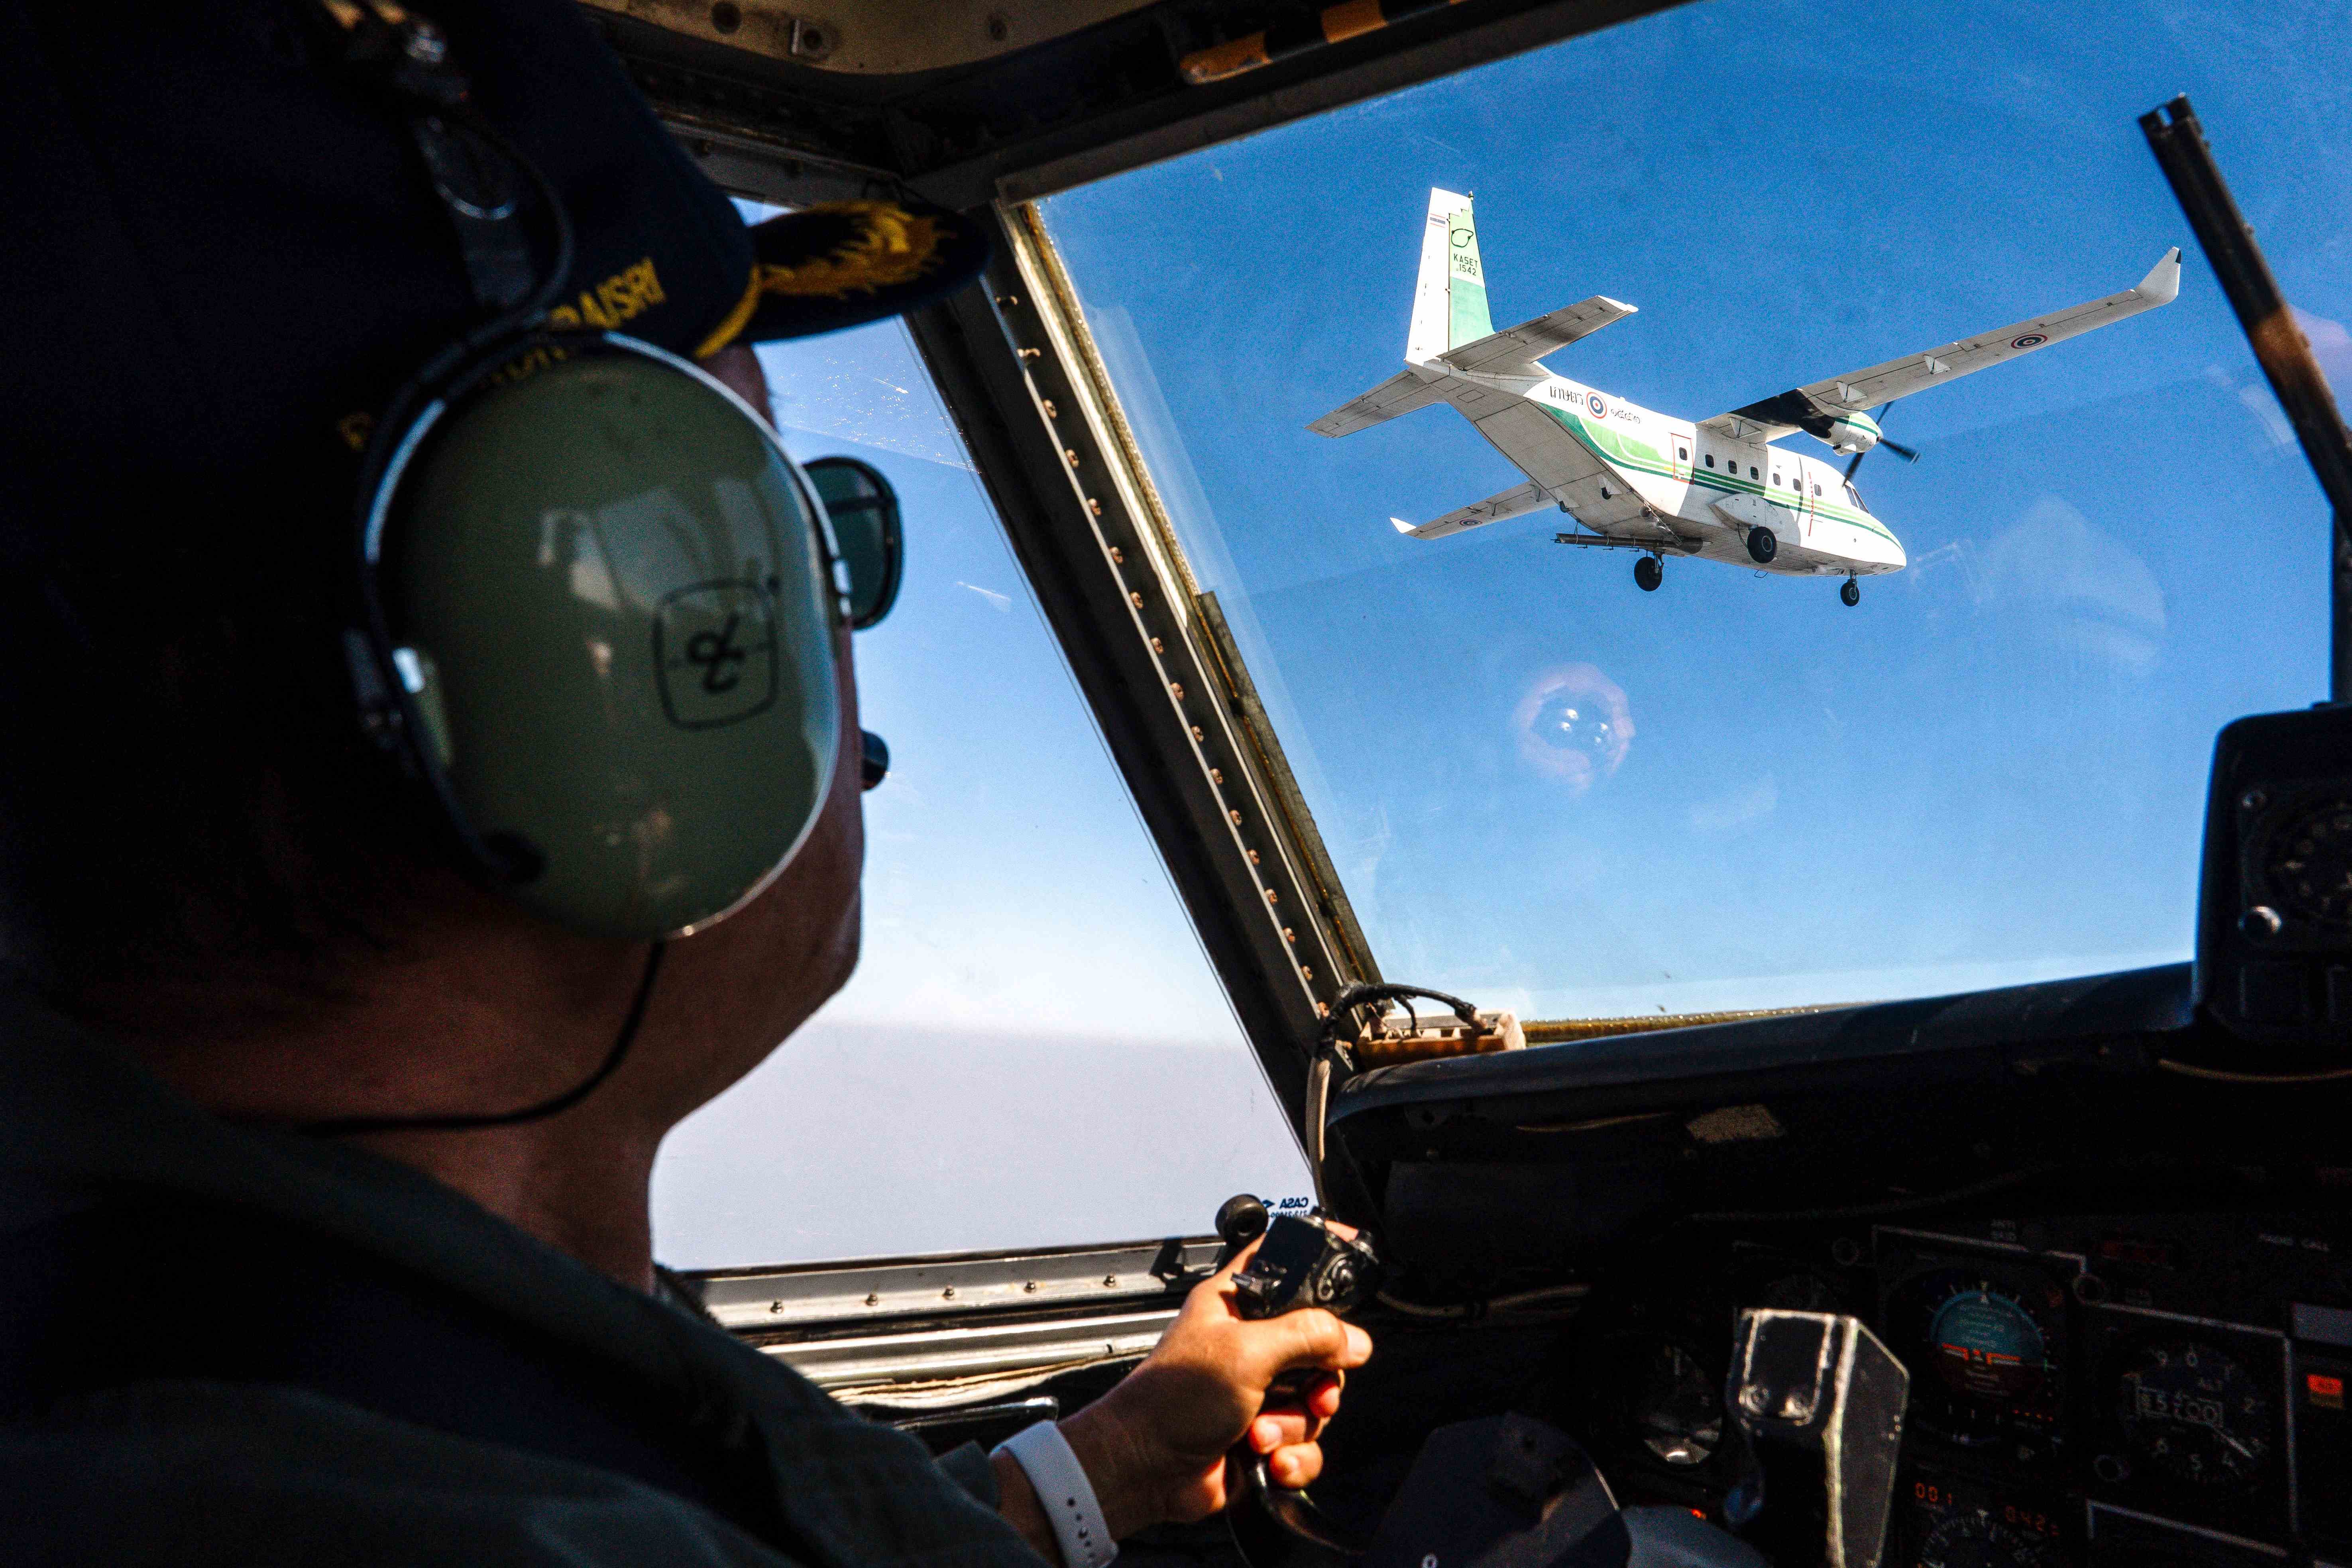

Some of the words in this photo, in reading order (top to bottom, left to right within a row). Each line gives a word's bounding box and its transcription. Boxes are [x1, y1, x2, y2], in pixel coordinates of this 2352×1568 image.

[1454, 253, 1478, 268] KASET
[1459, 263, 1477, 276] 1542
[1550, 385, 1584, 405] เกษตร
